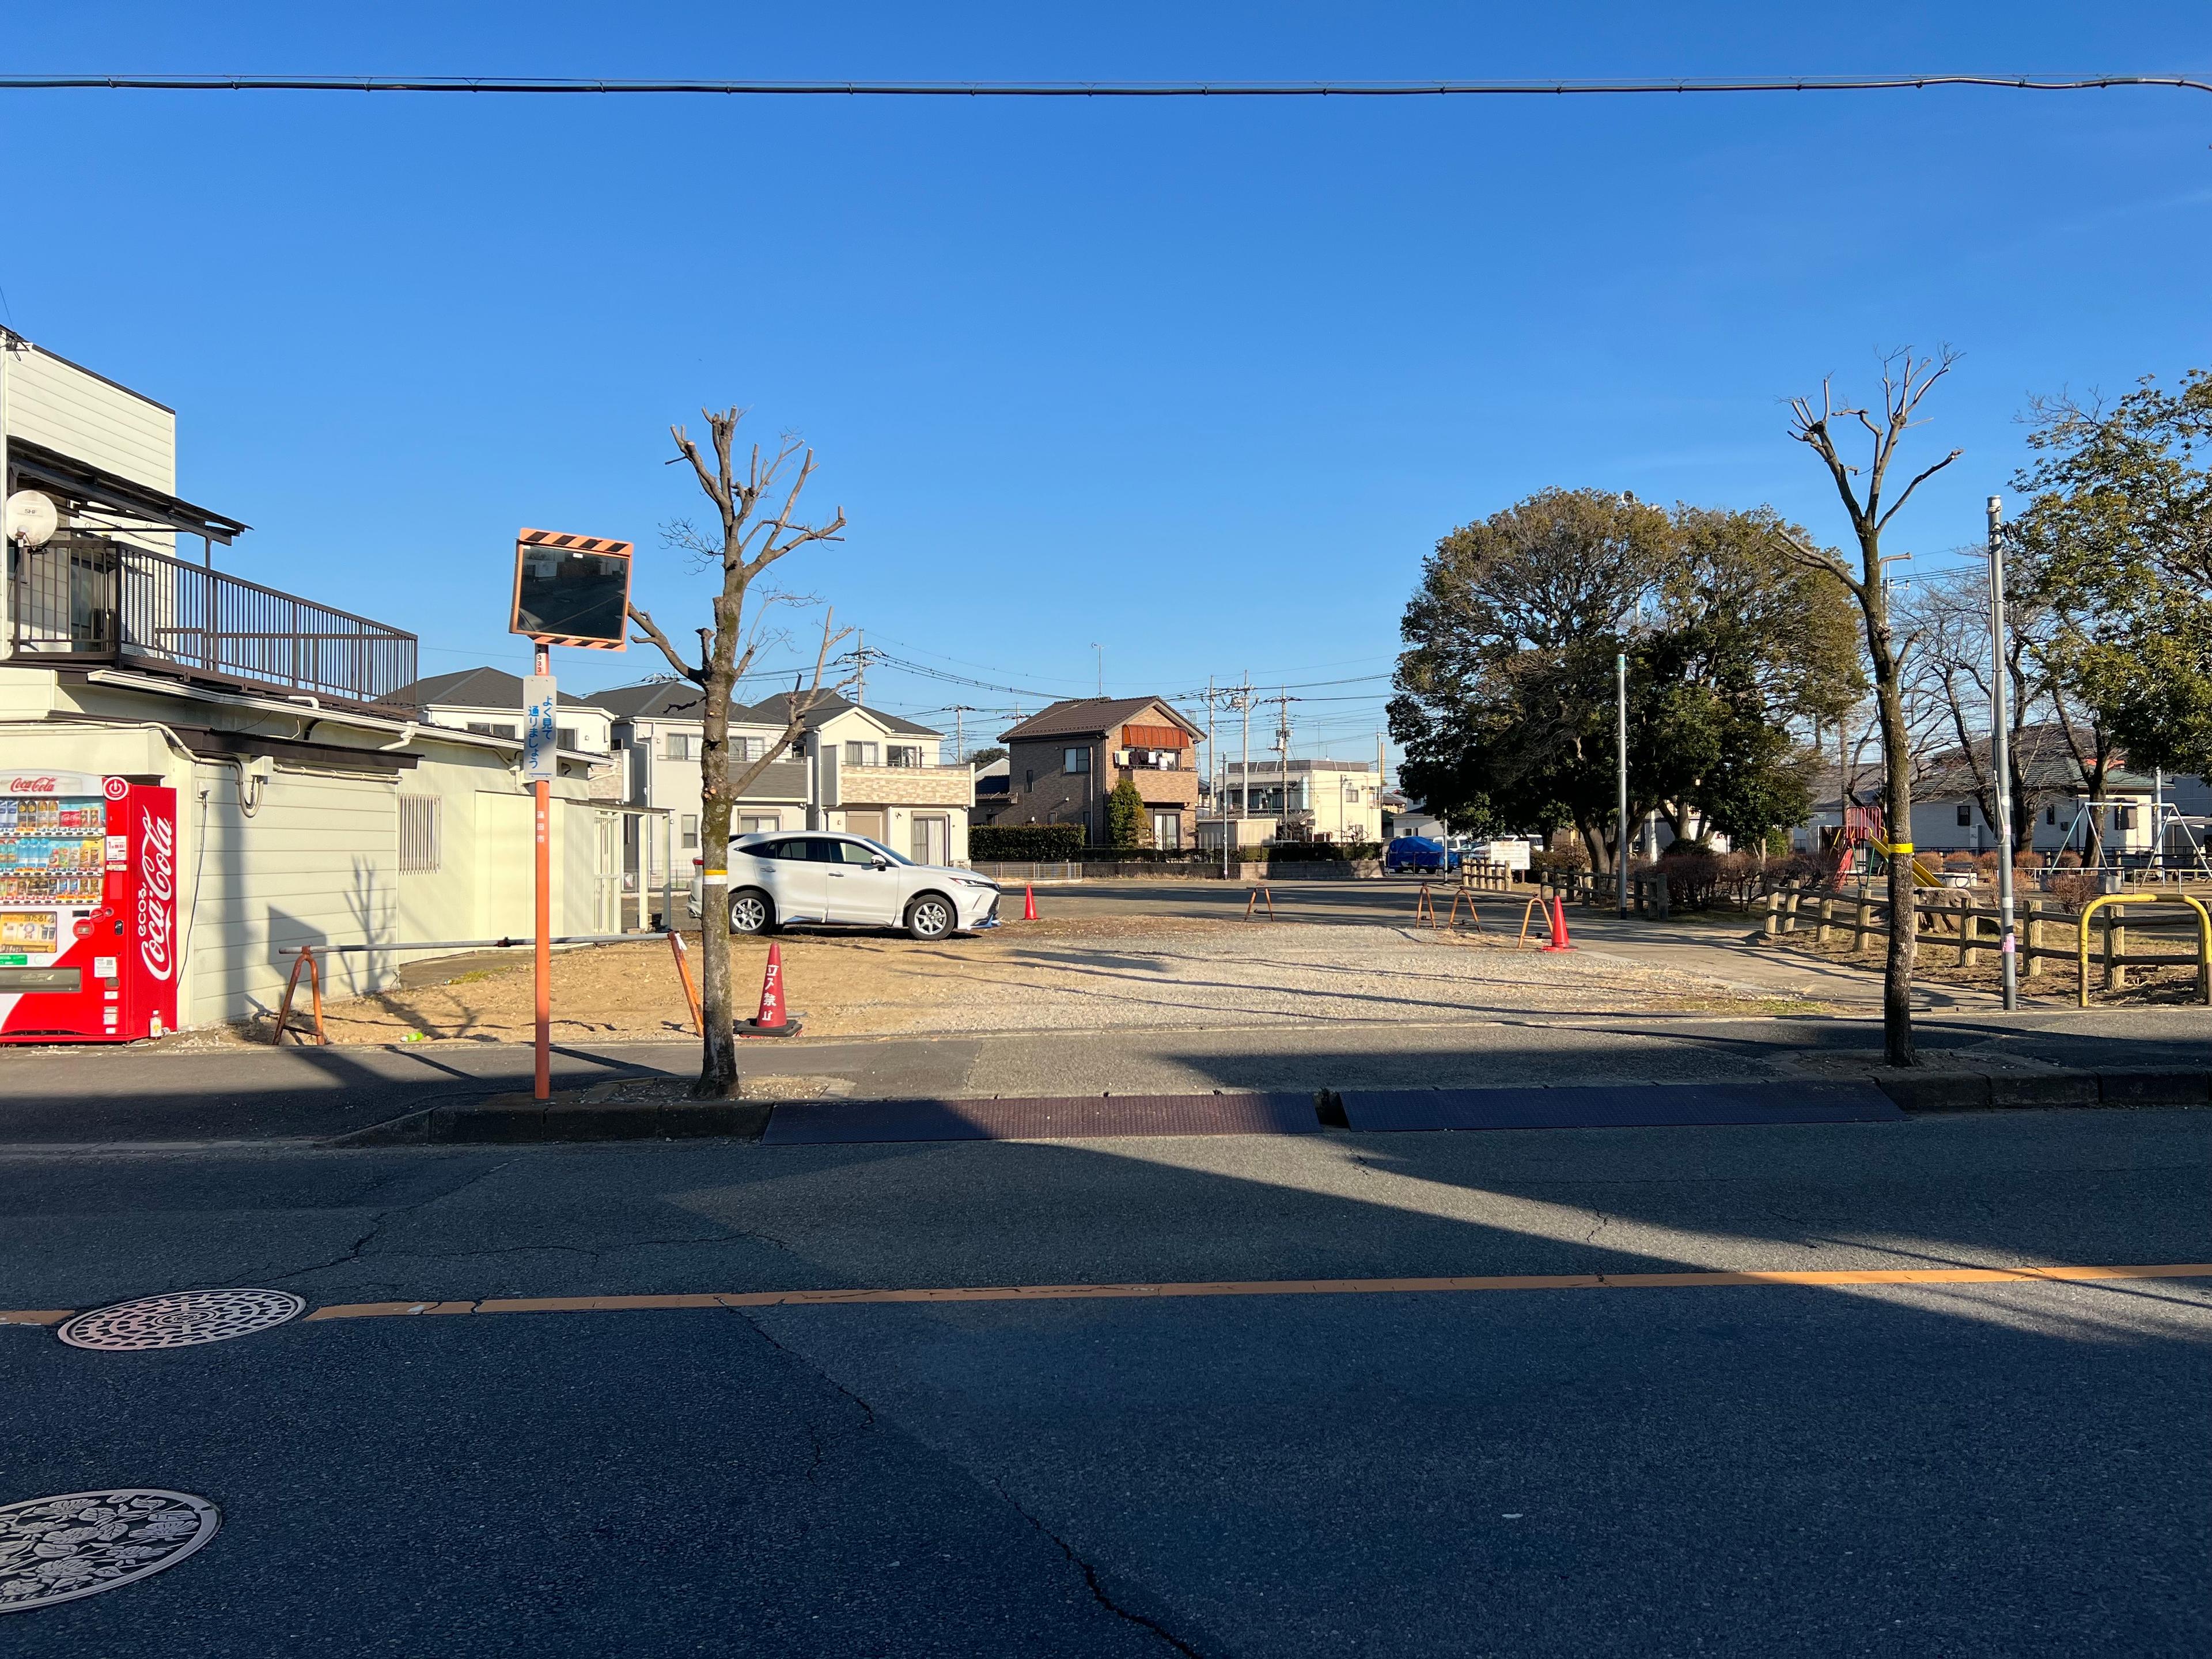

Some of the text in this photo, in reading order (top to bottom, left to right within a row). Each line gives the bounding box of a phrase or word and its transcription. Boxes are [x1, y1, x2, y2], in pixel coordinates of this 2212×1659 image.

[528, 705, 540, 769] 通りましょう
[542, 695, 553, 740] よく見て
[10, 777, 56, 792] Coca-Cola
[142, 805, 172, 981] Coca-Cola
[762, 964, 779, 1021] 立入禁止
